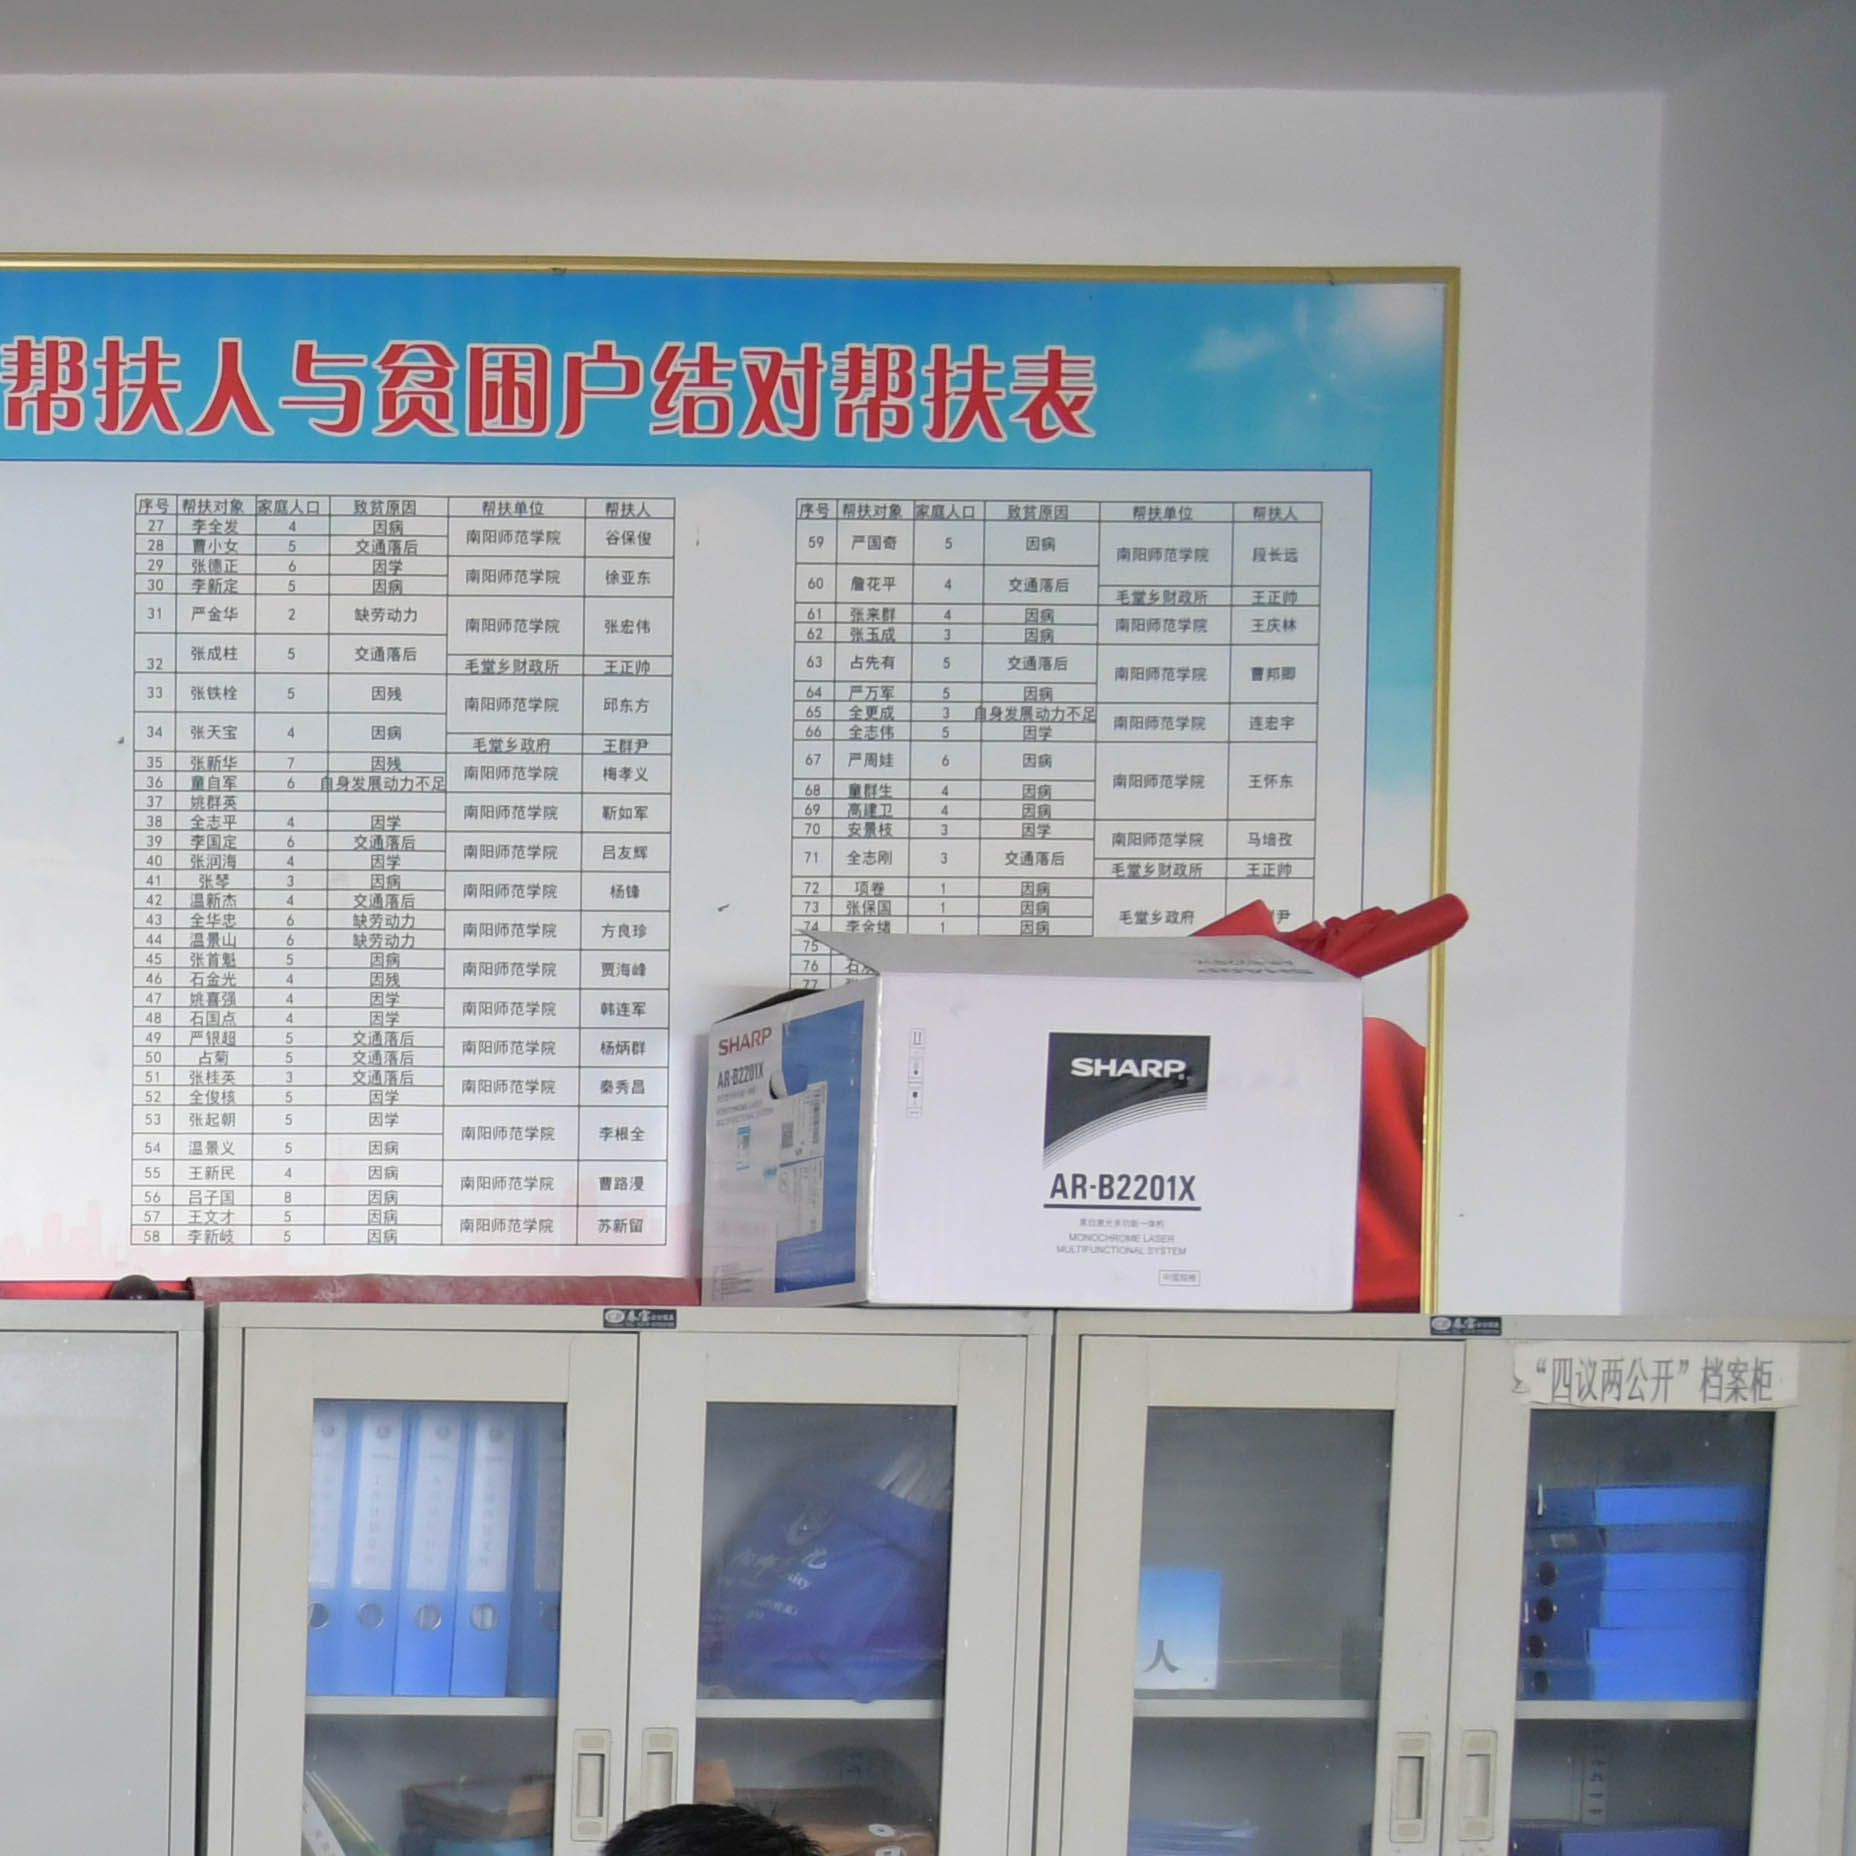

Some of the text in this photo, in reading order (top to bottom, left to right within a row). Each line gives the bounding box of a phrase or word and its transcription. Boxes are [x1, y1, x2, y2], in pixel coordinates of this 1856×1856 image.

[800, 502, 1193, 522] 序号 帮扶对象 致贫原因 帮扶单位
[355, 539, 418, 556] 交通落后
[808, 536, 824, 549] 59
[354, 607, 418, 624] 缺劳动力
[604, 618, 651, 635] 张宏伟
[603, 698, 649, 713] 邱东方
[1118, 909, 1195, 925] 毛堂乡政府
[718, 1027, 772, 1056] SHARP
[717, 1061, 764, 1089] AR-B2201X
[1071, 1057, 1185, 1079] SHARP
[1050, 1173, 1196, 1201] AR-B2201X
[1535, 1356, 1775, 1404] “四议两公开”档案柜
